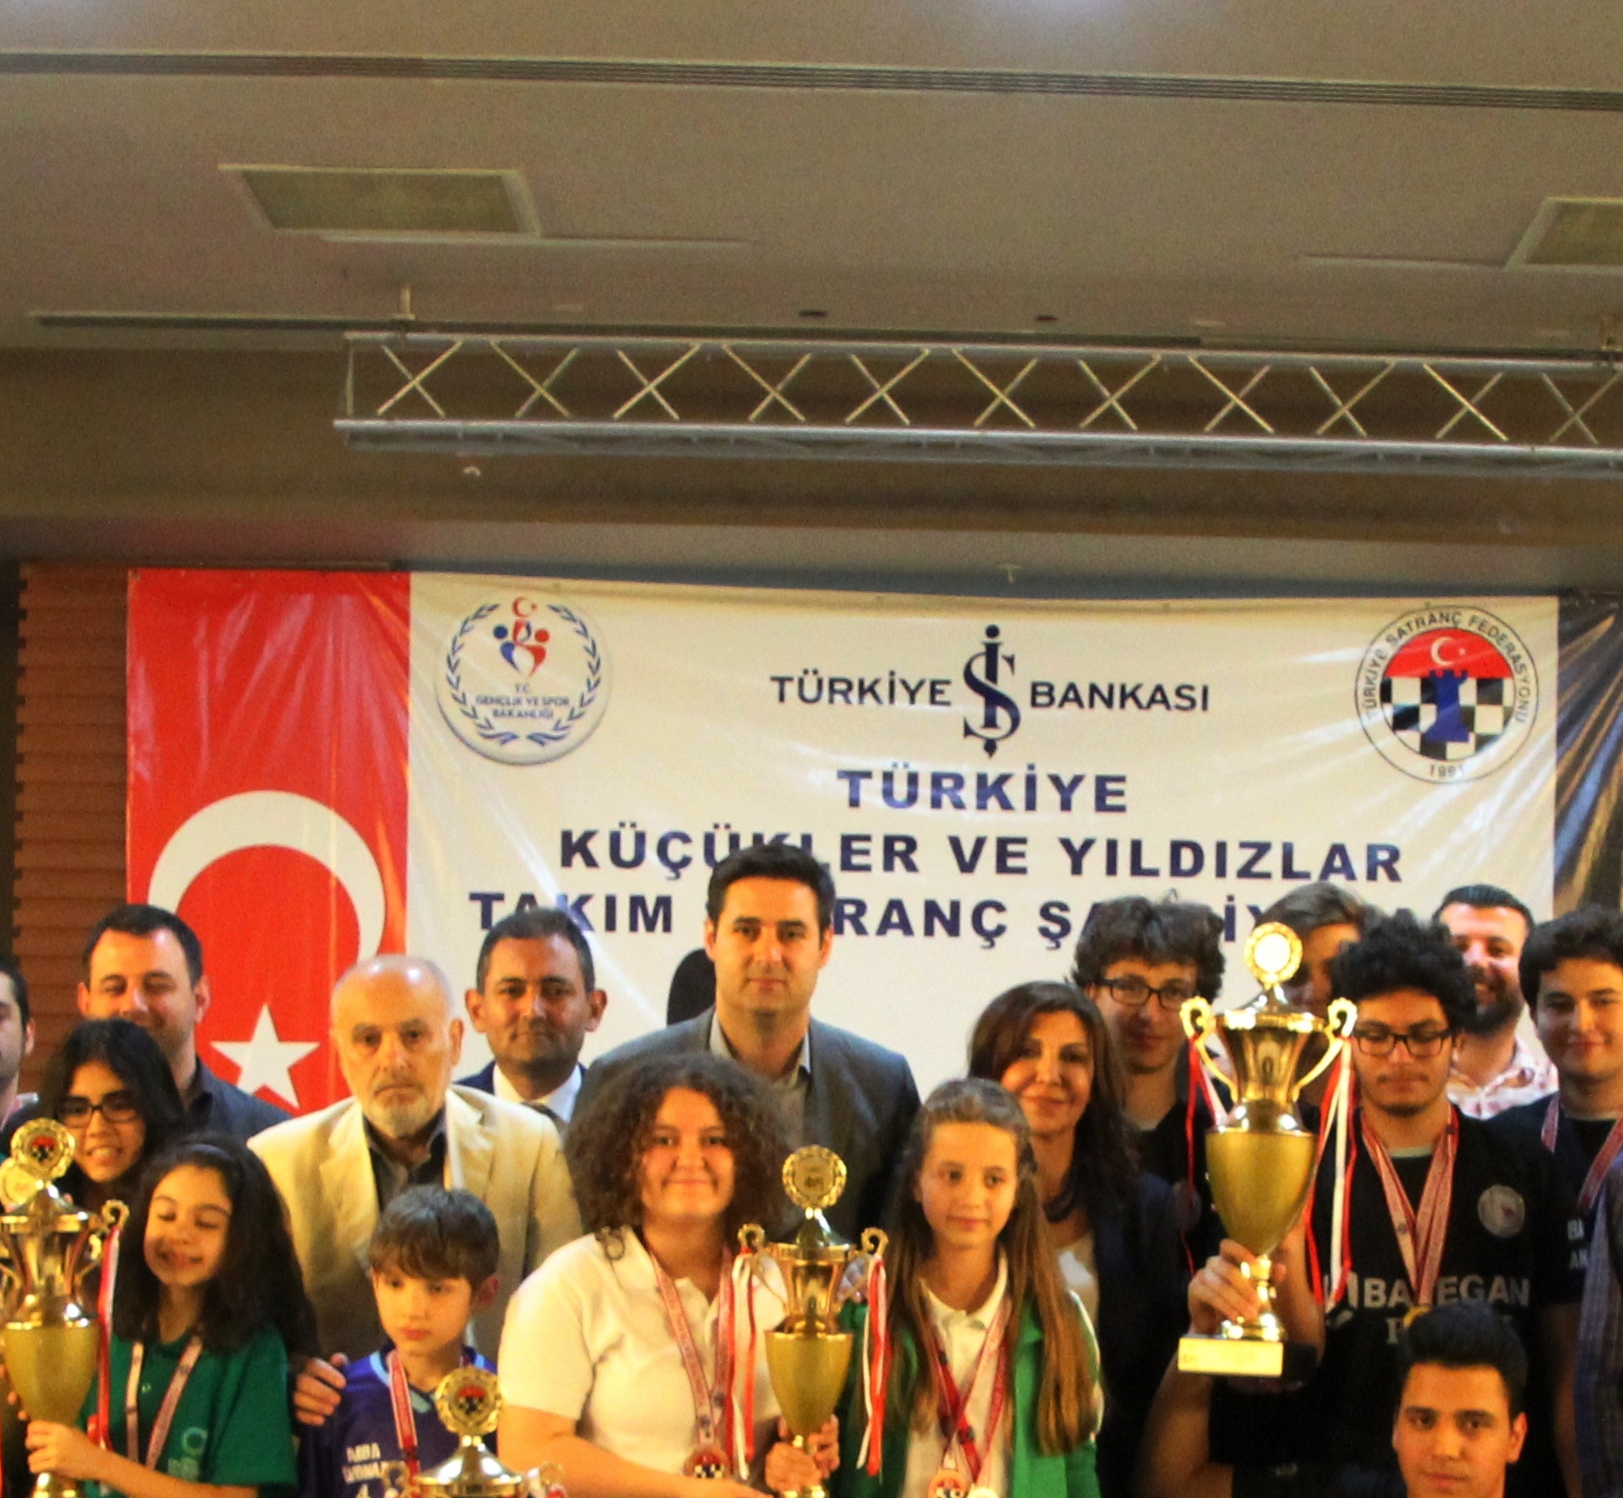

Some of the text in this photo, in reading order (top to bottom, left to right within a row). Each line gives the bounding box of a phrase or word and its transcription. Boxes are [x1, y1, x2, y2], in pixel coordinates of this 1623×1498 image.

[769, 668, 952, 707] TÜRKİYE
[1030, 680, 1211, 712] BANKASI
[1386, 611, 1462, 647] SATRANÇ
[1468, 613, 1531, 724] FEDERASYONU
[836, 761, 1128, 813] TÜRKİYE
[948, 835, 1030, 876] VE
[1057, 837, 1403, 883] YILDIZLAR
[832, 897, 1008, 950] RANÇ
[1363, 1274, 1530, 1310] BAEGAN
